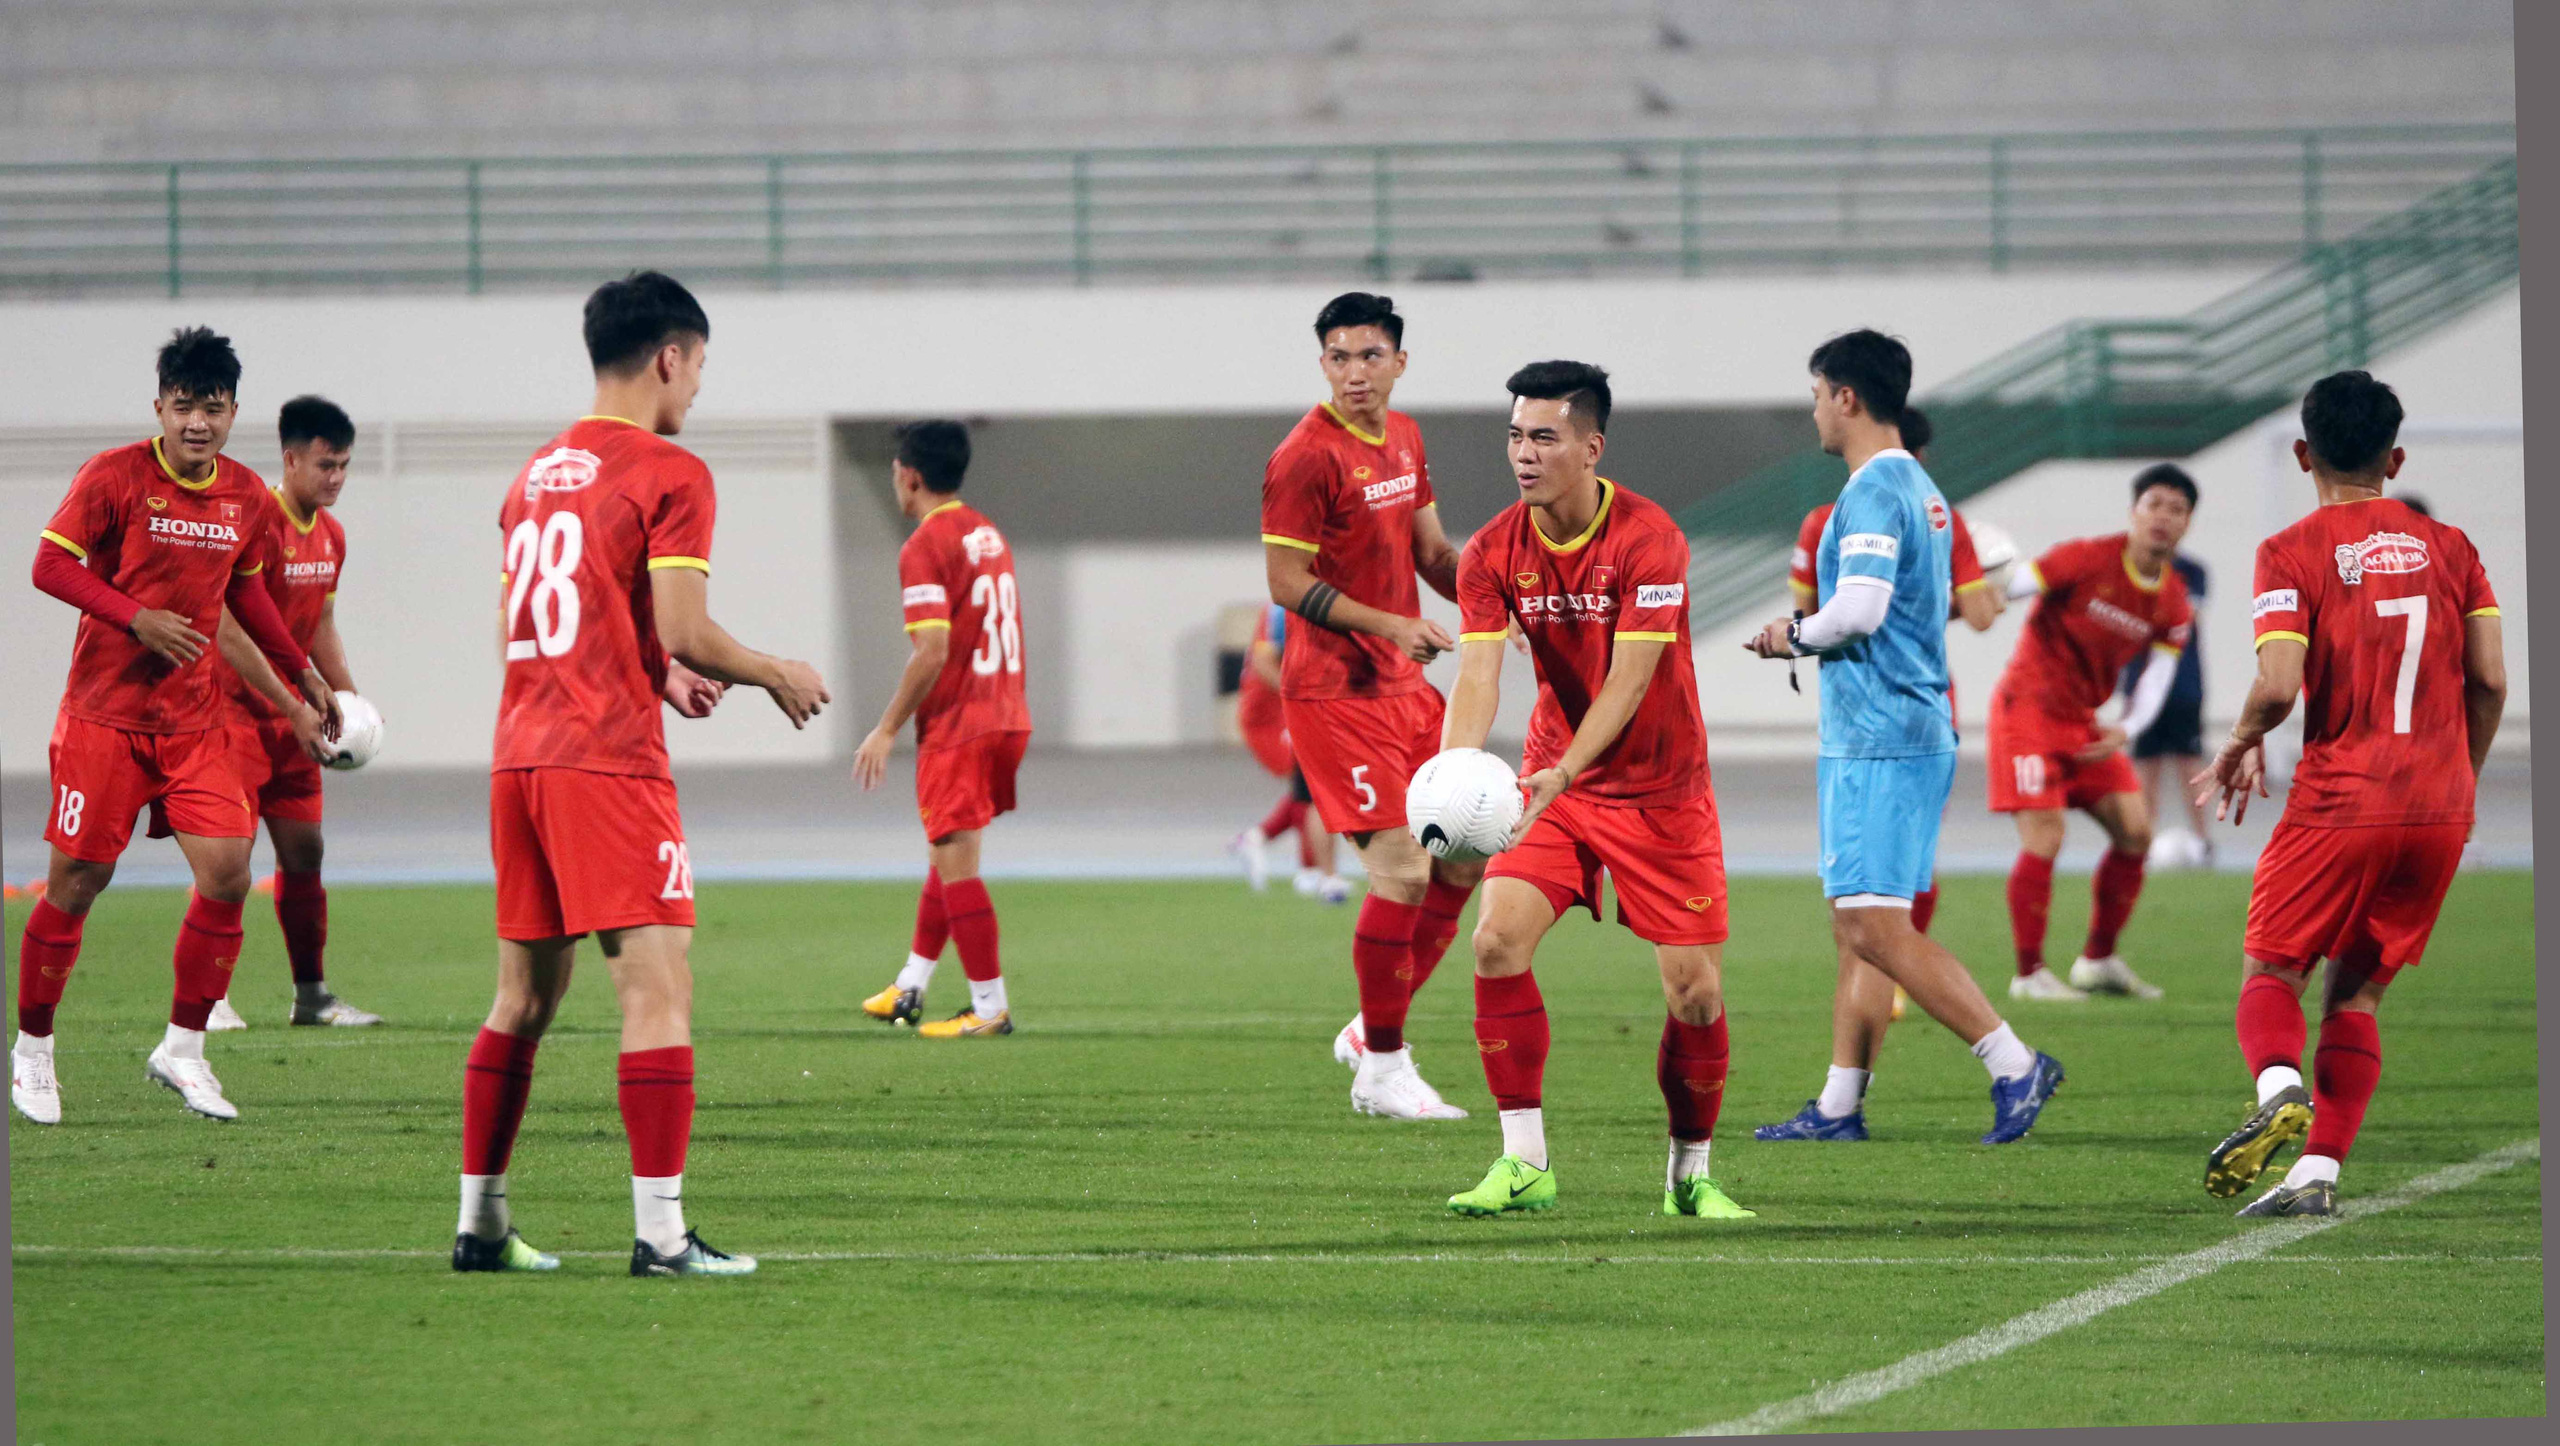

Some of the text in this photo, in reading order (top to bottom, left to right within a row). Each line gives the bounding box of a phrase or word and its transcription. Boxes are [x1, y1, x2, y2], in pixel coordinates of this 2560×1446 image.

[149, 516, 240, 541] HONDA
[151, 534, 169, 543] The
[169, 537, 195, 547] Power
[197, 540, 206, 549] of
[2355, 534, 2378, 552] Cook
[284, 561, 336, 577] HONDA
[507, 511, 583, 660] 28
[971, 571, 1021, 675] 38
[2374, 594, 2428, 734] 7
[1351, 764, 1377, 812] 5
[2014, 753, 2046, 796] 10
[57, 783, 85, 836] 18
[658, 840, 694, 899] 28
